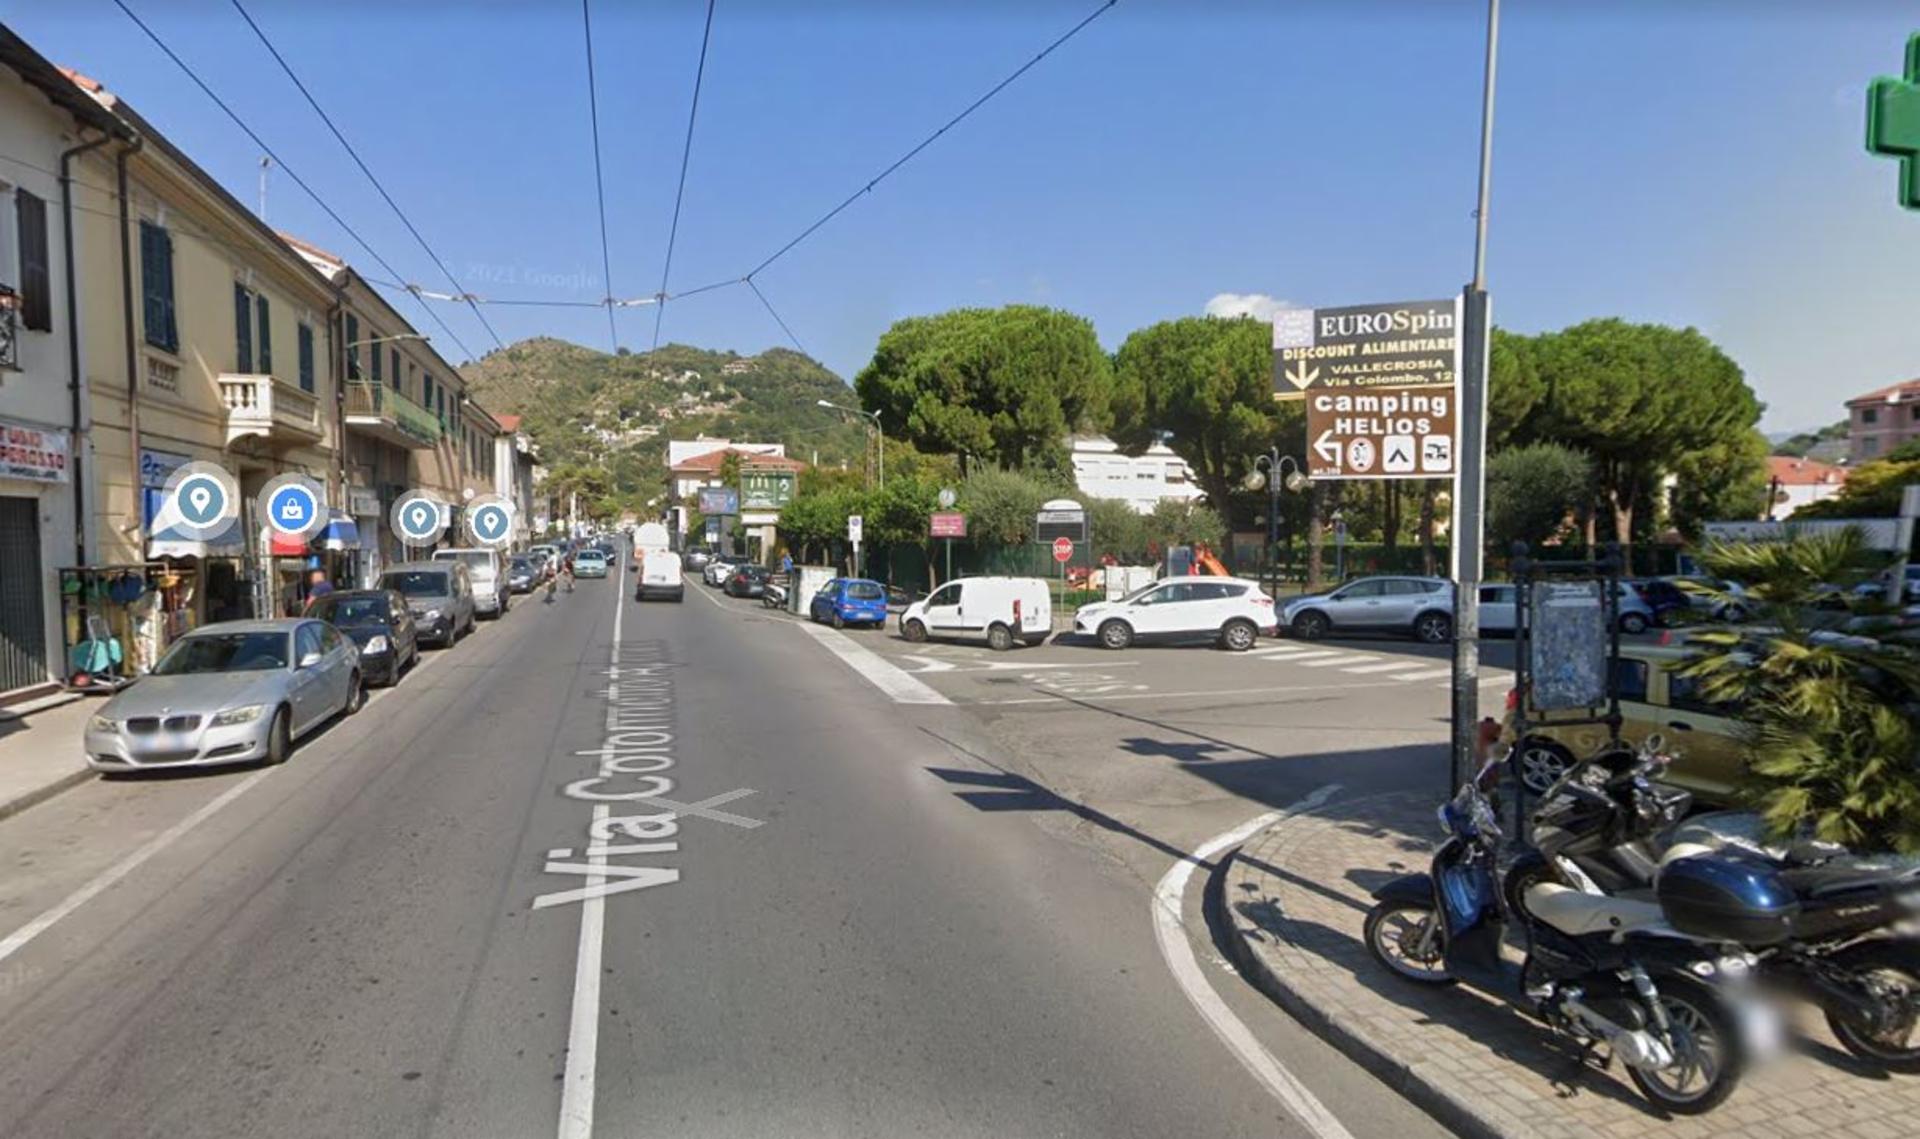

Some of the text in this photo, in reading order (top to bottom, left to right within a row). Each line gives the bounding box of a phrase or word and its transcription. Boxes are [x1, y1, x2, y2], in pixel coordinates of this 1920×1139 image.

[1321, 310, 1452, 337] EUROSpin
[1283, 338, 1455, 361] DISCOUNT ALIMENTARE
[1331, 360, 1445, 374] VALLECROSIA
[1324, 378, 1350, 387] Via
[1315, 392, 1447, 417] camping
[1335, 418, 1431, 435] HELIOS
